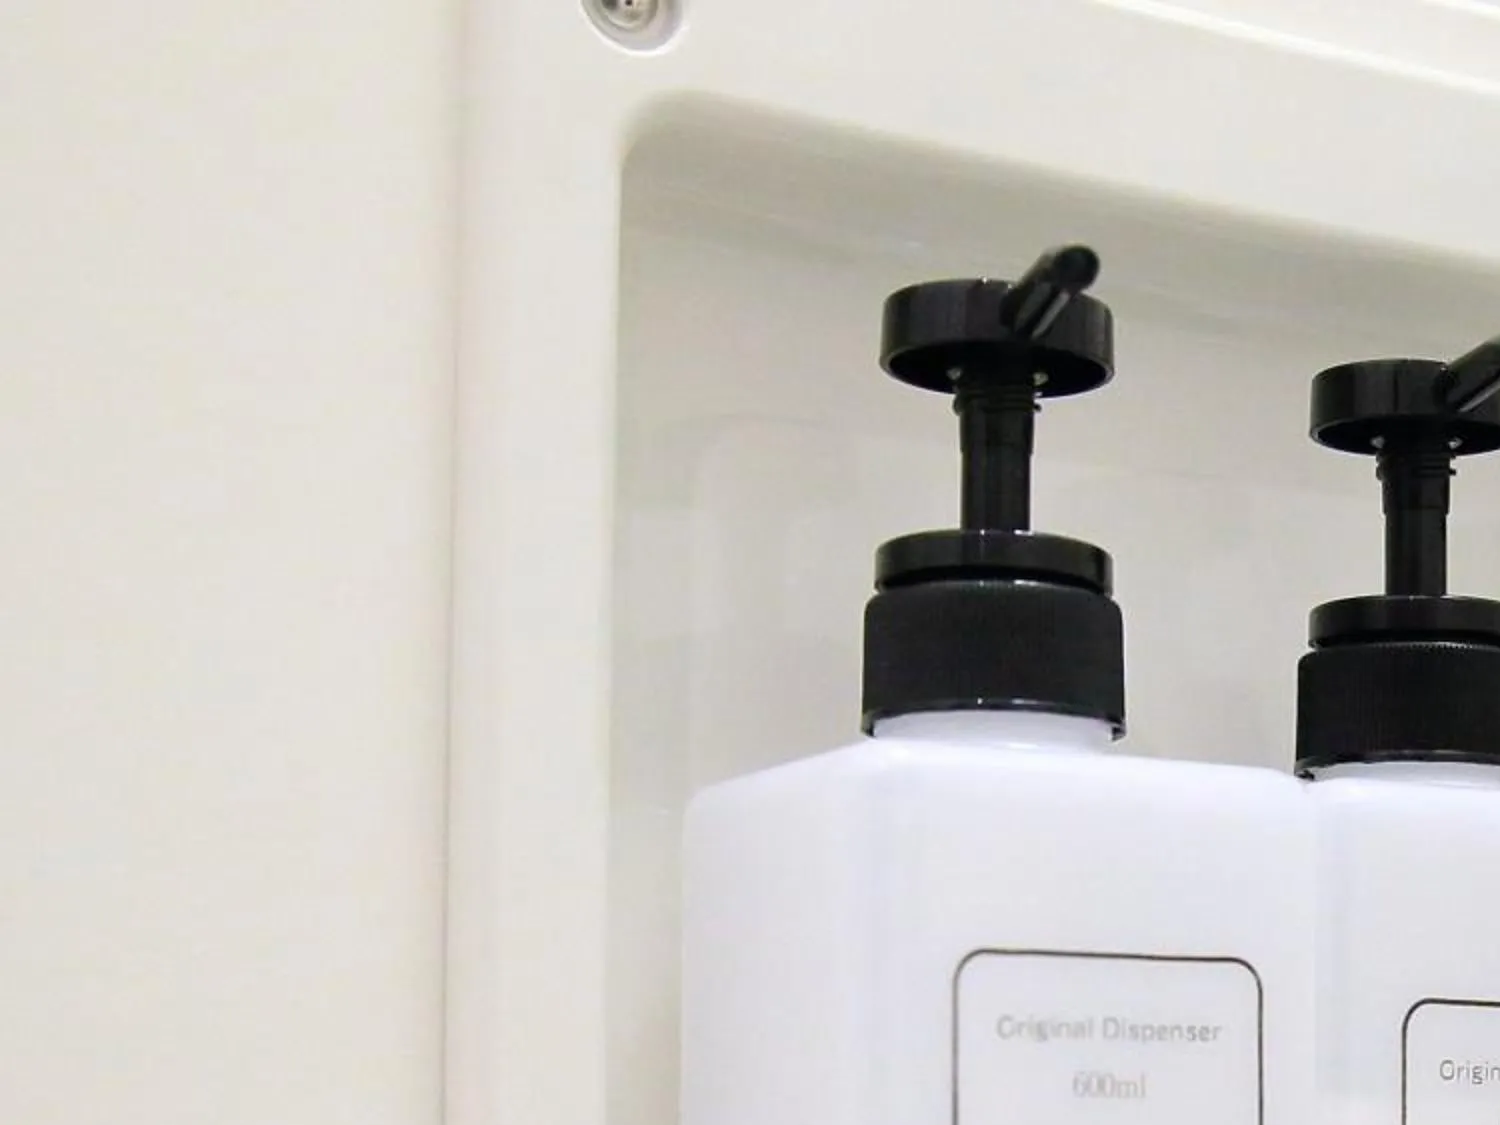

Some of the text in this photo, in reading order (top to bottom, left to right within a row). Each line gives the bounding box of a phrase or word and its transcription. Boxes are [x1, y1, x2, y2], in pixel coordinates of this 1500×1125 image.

[996, 1014, 1223, 1044] Original Dispenser
[1072, 1070, 1146, 1099] 600ml
